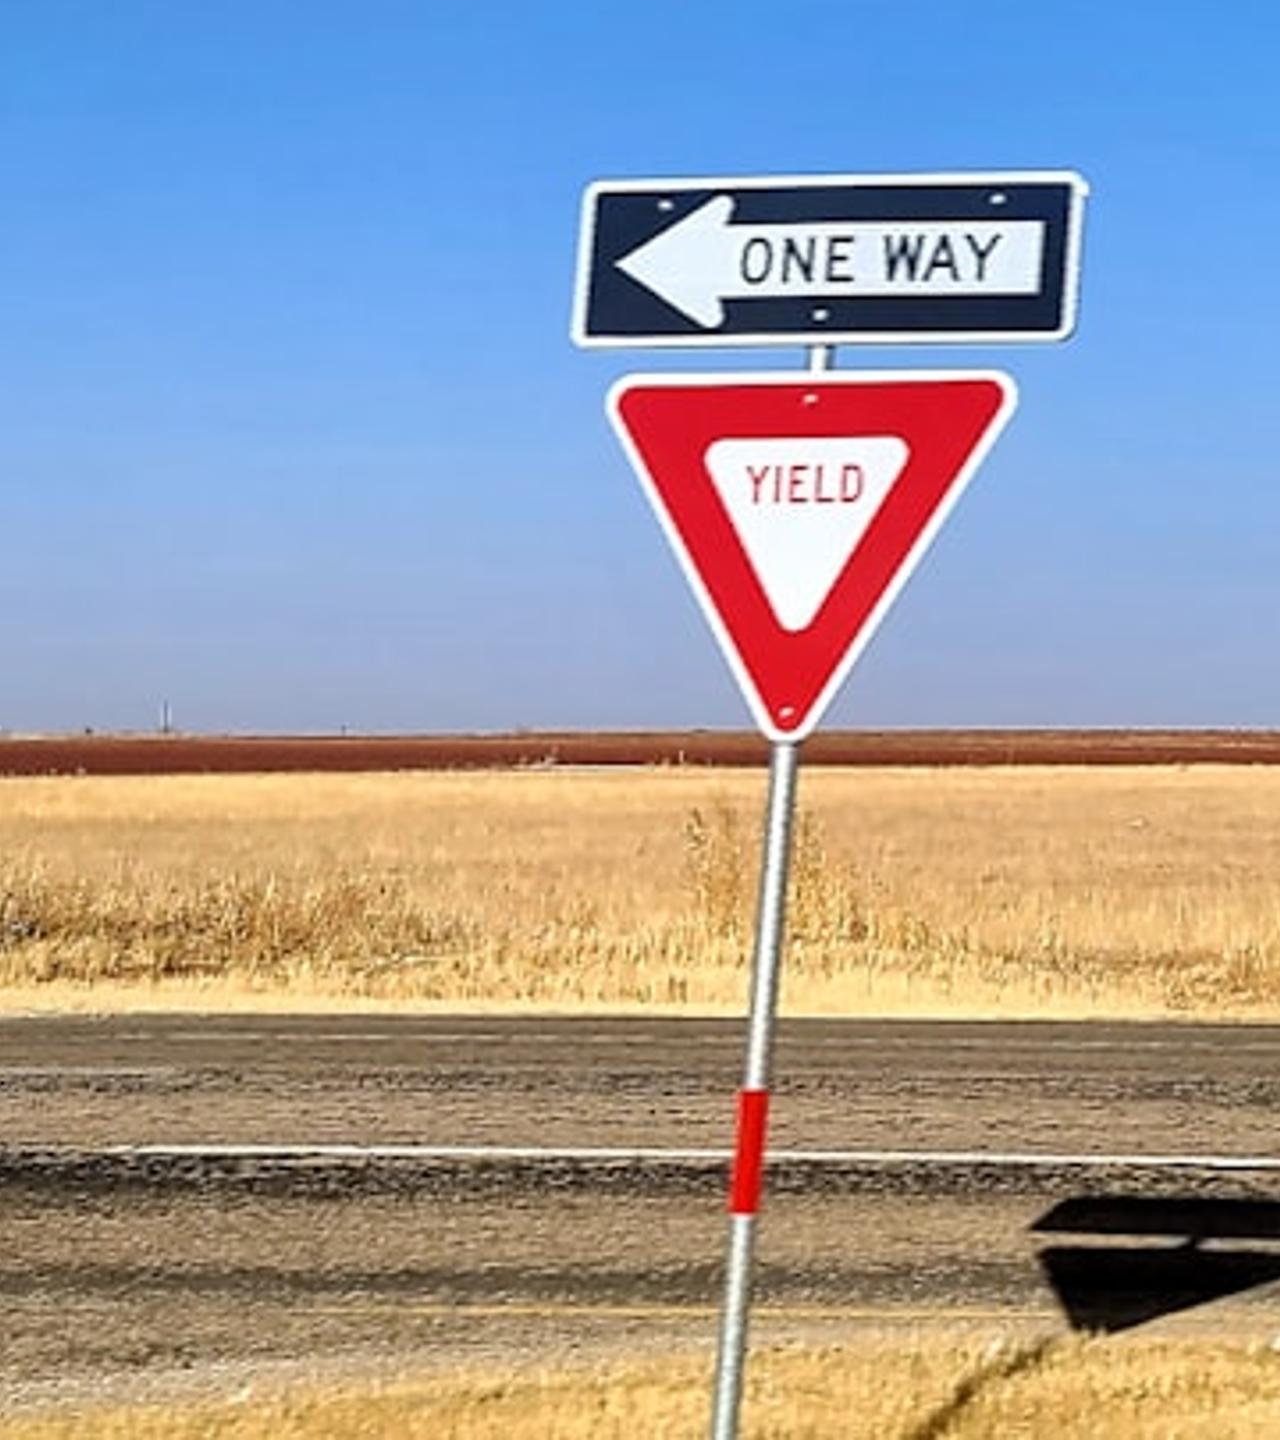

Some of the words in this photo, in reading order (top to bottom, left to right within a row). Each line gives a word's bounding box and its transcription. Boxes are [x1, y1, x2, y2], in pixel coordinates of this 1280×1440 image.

[740, 236, 855, 286] ONE
[883, 233, 1003, 283] WAY
[746, 464, 863, 504] YIELD
